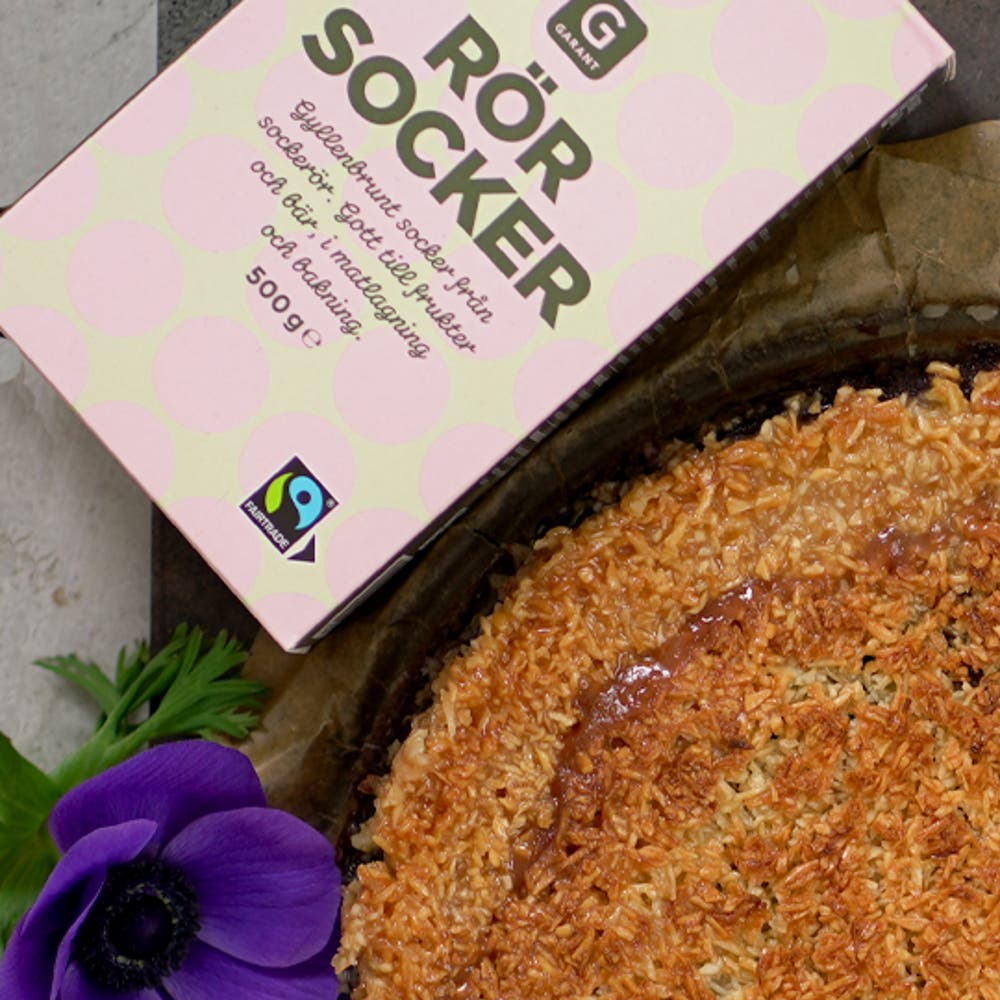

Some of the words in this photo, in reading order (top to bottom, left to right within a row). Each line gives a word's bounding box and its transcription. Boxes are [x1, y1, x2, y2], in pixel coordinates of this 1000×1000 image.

[555, 23, 600, 71] GARANT
[423, 14, 592, 205] RÖR
[250, 160, 287, 195] och
[282, 193, 318, 239] bär,
[290, 99, 402, 219] Gyllenbrunt
[396, 218, 455, 277] socker
[443, 276, 493, 325] från
[301, 8, 592, 330] SOCKER
[257, 116, 335, 204] sockerör.
[334, 201, 384, 250] Gott
[378, 248, 418, 287] till
[402, 283, 477, 354] frukter
[260, 224, 298, 260] och
[292, 257, 363, 341] bakning.
[320, 235, 339, 250] i
[329, 250, 431, 359] matlagning
[244, 500, 290, 549] FAIRTRADE
